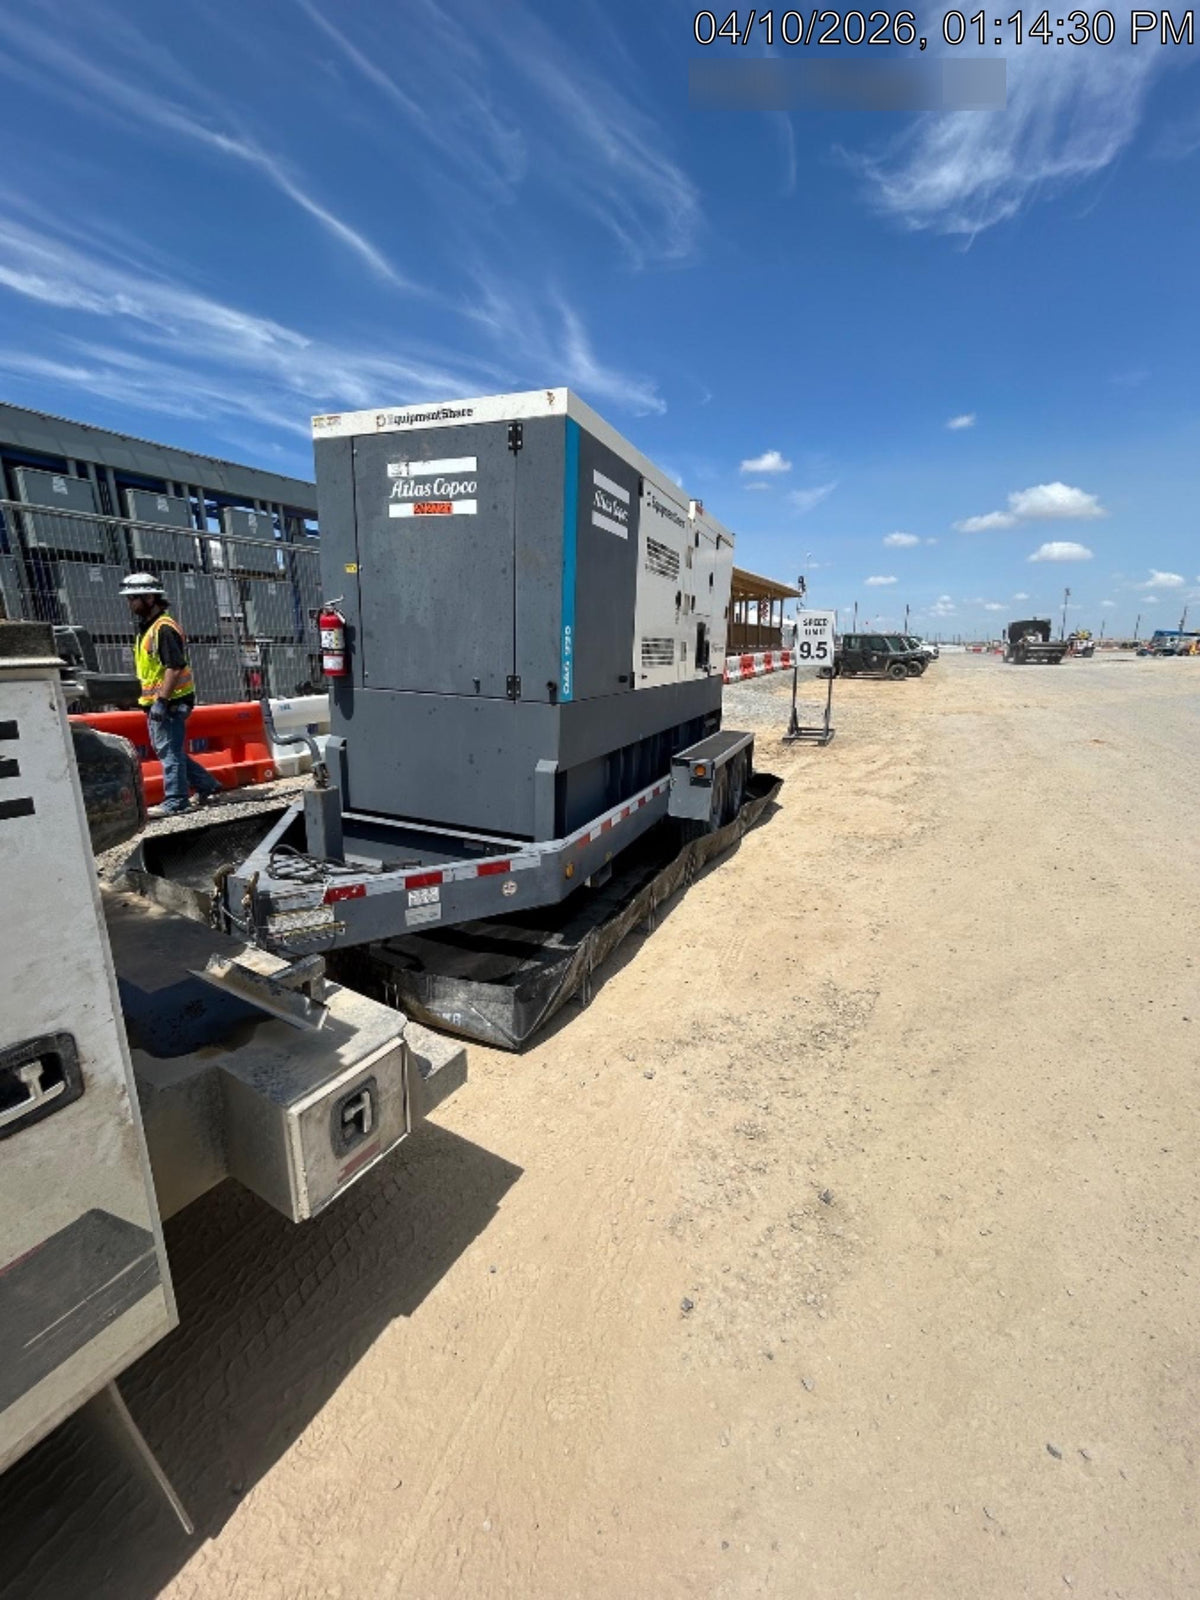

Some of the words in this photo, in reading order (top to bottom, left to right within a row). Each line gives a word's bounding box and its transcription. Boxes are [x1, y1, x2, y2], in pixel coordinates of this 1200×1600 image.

[389, 480, 432, 499] Atlas
[433, 478, 478, 499] Copco
[800, 641, 827, 659] 9.5
